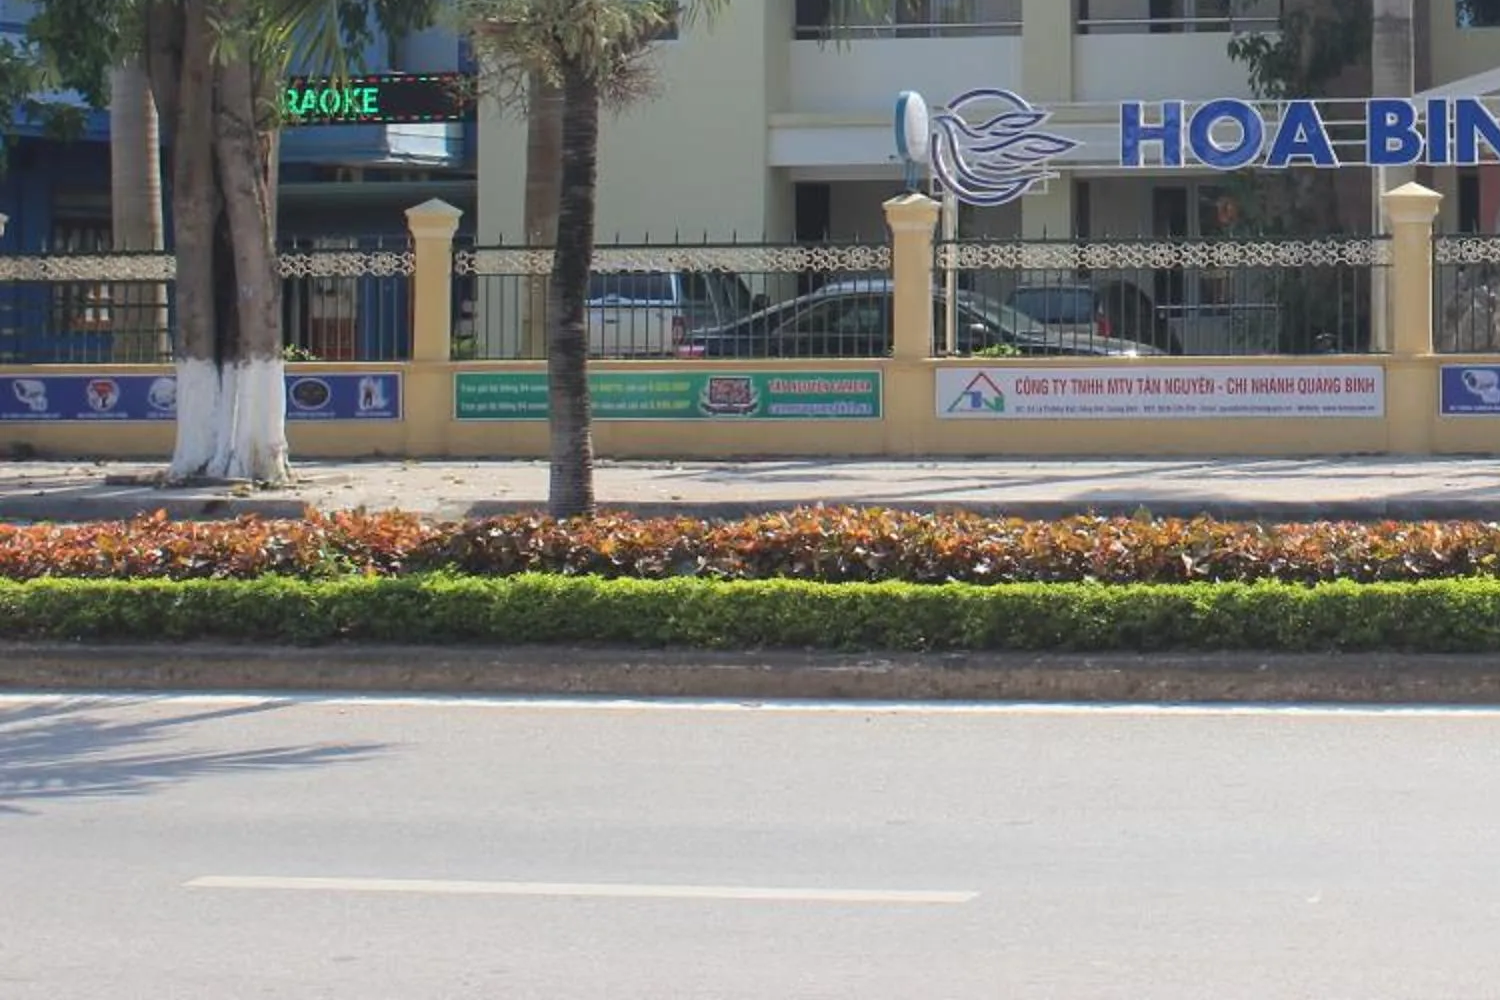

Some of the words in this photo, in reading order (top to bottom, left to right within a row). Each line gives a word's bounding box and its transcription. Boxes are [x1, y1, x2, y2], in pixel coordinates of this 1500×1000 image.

[1119, 98, 1341, 169] HOA
[1015, 375, 1049, 395] CÔNG
[1052, 378, 1067, 395] TY
[1070, 378, 1103, 395] TNHH
[1107, 377, 1133, 395] MTV
[1226, 377, 1247, 395] CHI
